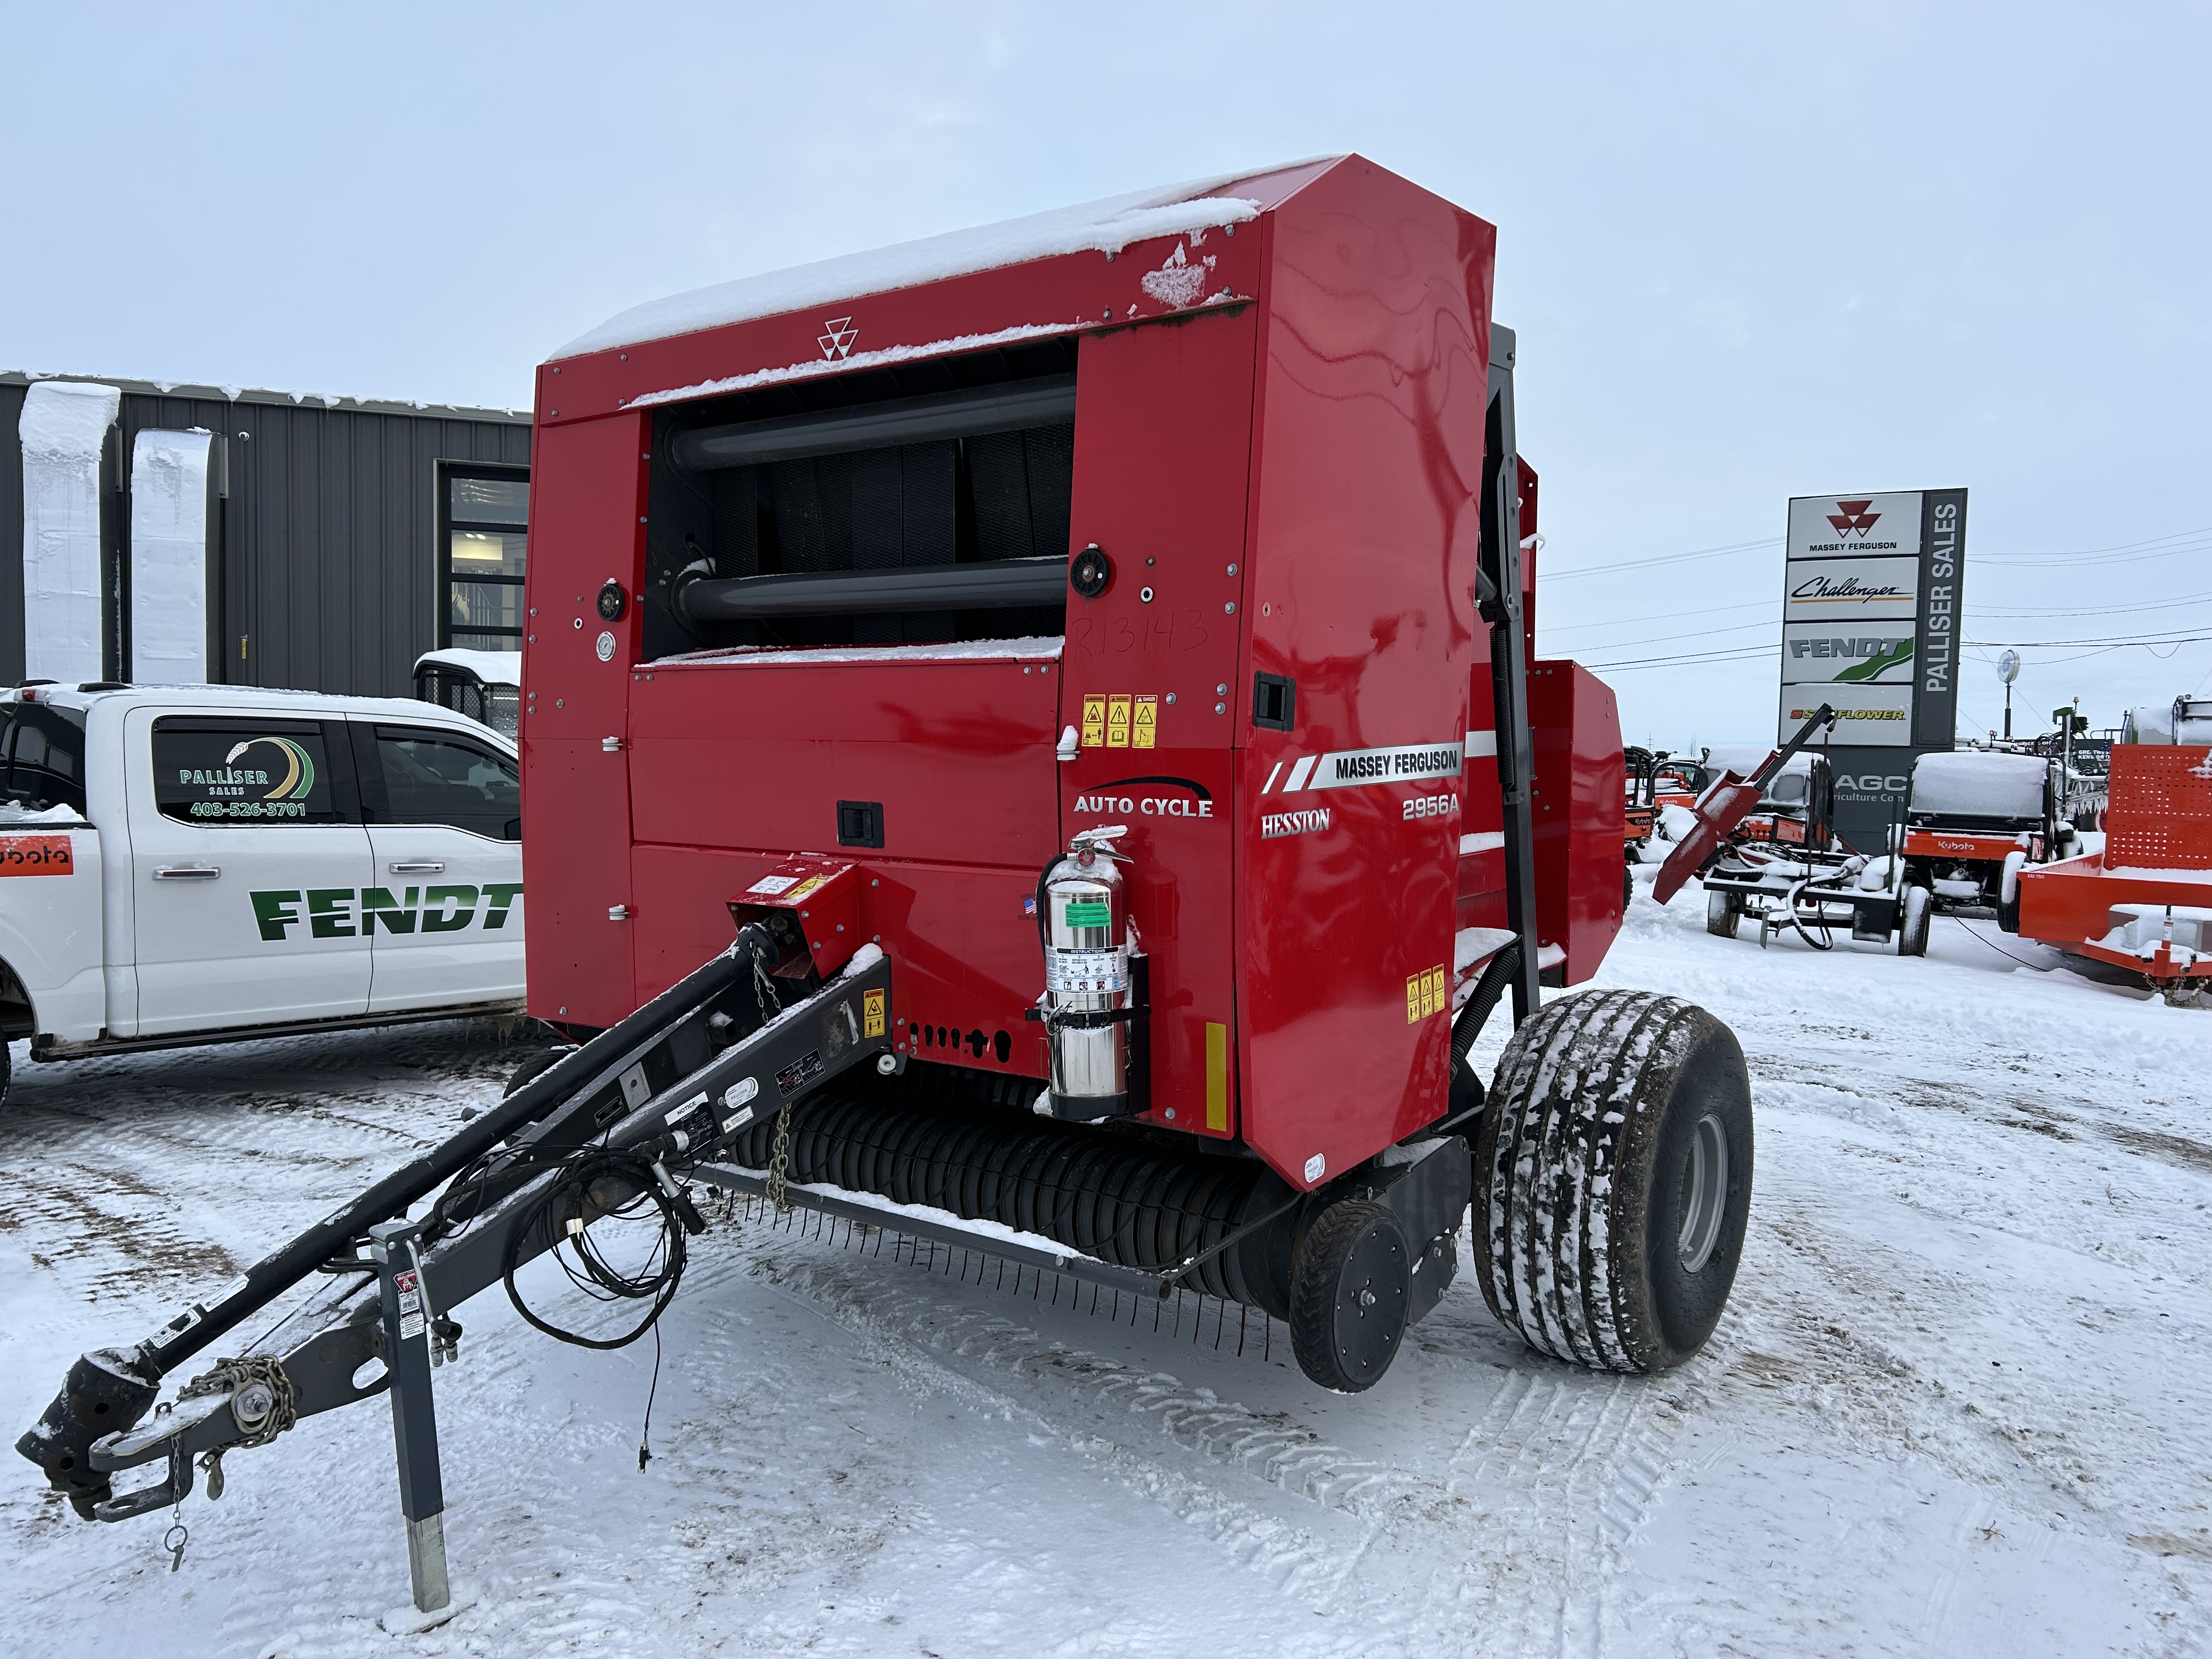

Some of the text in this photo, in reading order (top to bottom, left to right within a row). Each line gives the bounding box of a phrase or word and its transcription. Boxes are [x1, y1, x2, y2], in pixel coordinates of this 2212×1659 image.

[1809, 542, 1897, 551] MASSEY FERGUSON
[1792, 576, 1910, 603] Challenger
[1926, 503, 1957, 691] PALLISER SALES
[1071, 610, 1208, 661] R13143
[1789, 637, 1907, 658] FENDT
[1803, 709, 1905, 720] SFLOWER
[1335, 750, 1457, 780] MASSEY FERGUSON
[180, 768, 268, 785] PALLISER
[1835, 775, 1908, 791] AGC
[209, 787, 244, 795] SALES
[1833, 792, 1877, 802] riculture
[190, 802, 306, 816] 403-526-3701
[1074, 796, 1213, 817] AUTO CYCLE
[1403, 793, 1460, 821] 2956A
[1261, 808, 1330, 839] HESSTON
[1938, 840, 1974, 850] Kubota
[249, 882, 524, 941] FENDT
[677, 1101, 696, 1115] NOTICE
